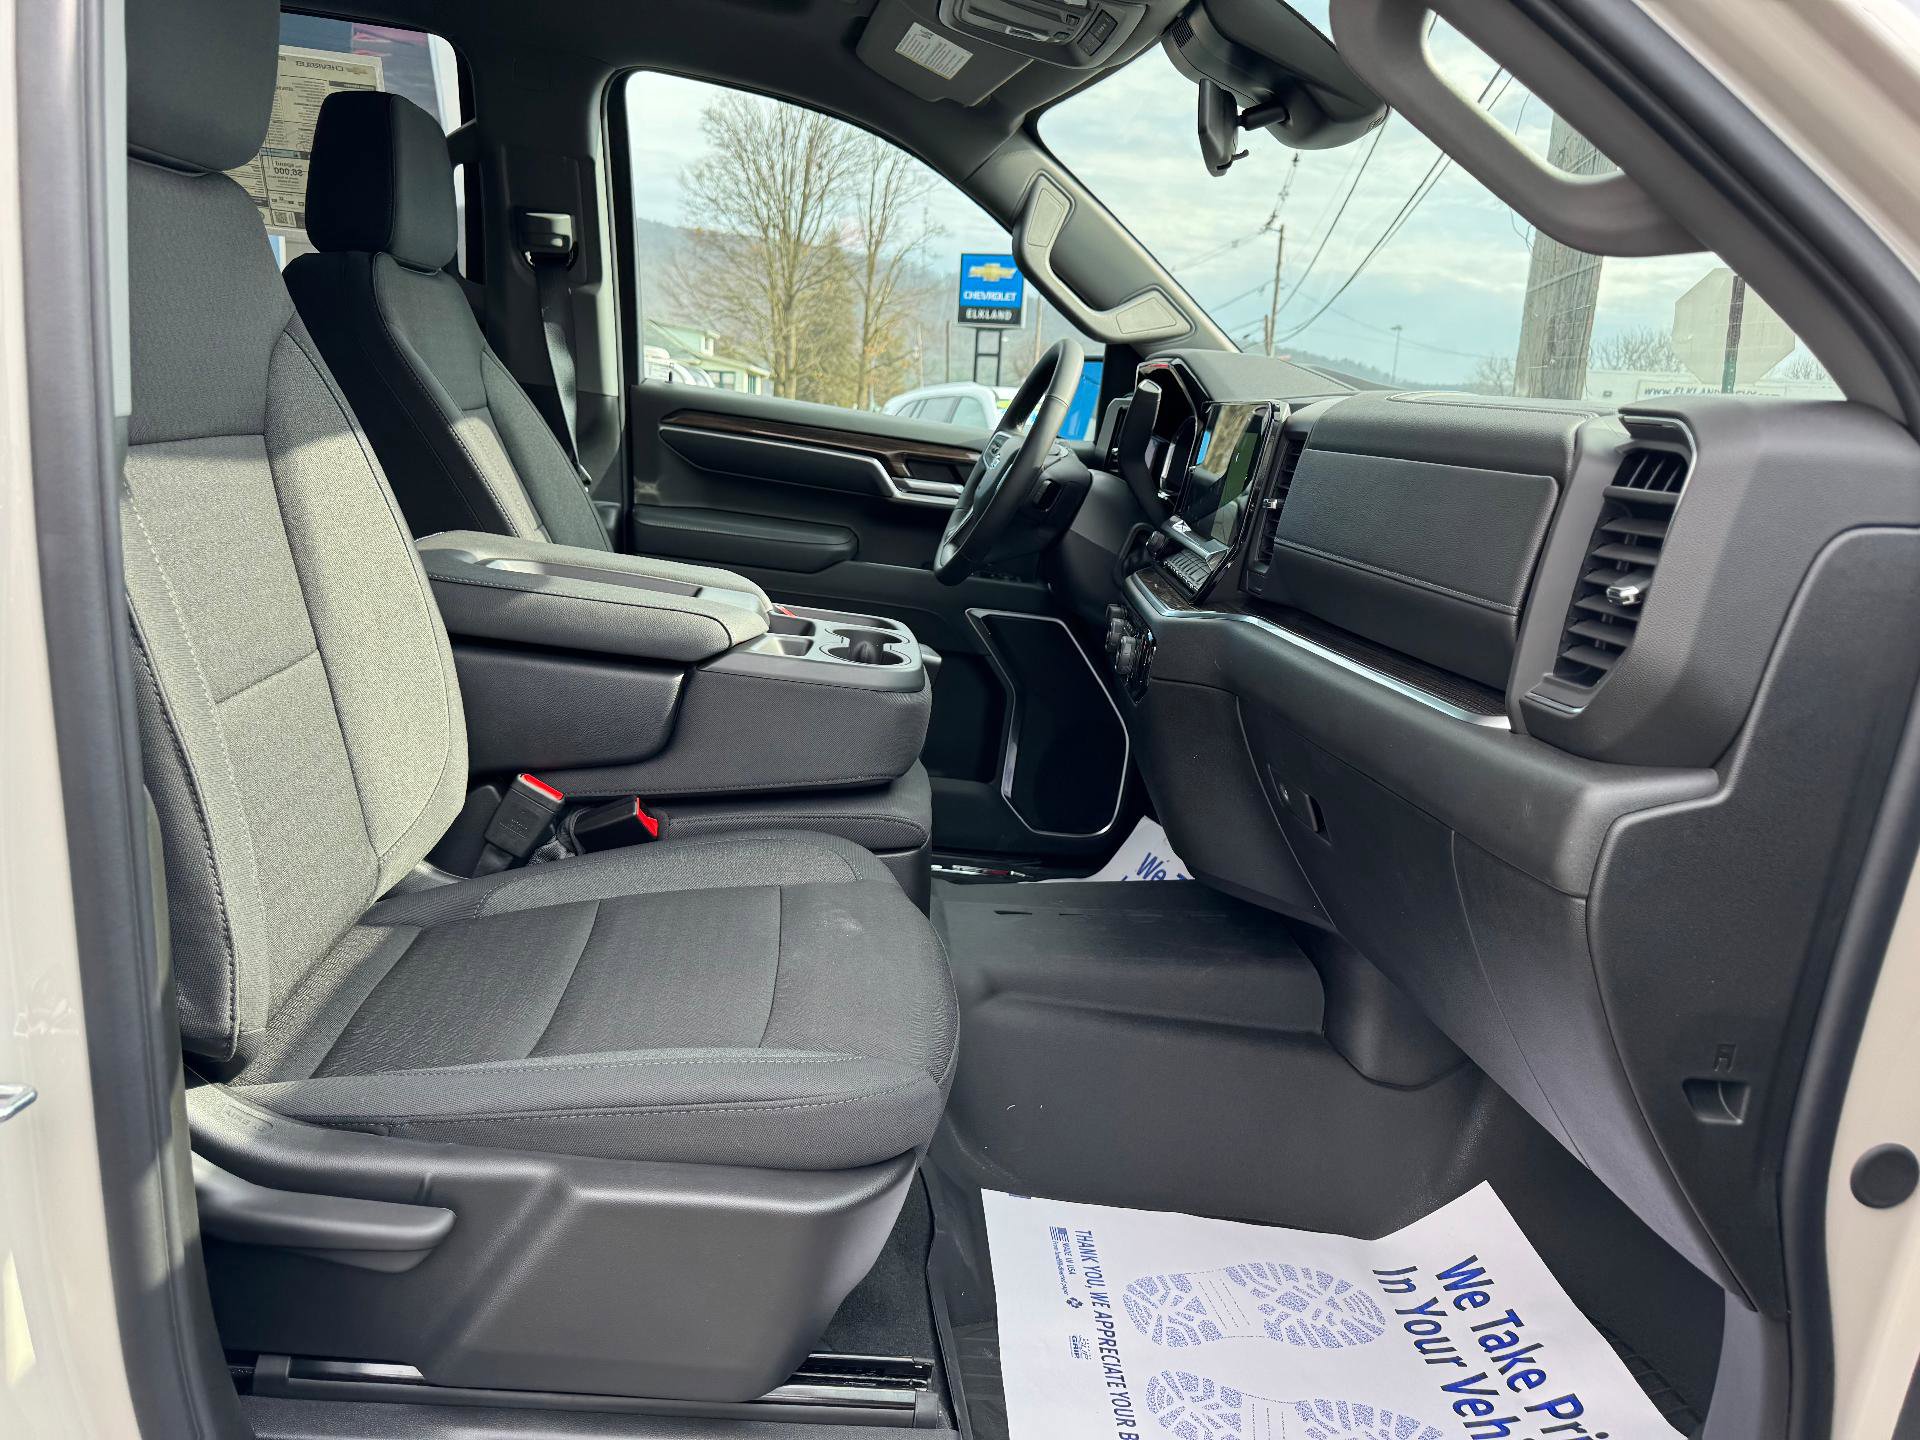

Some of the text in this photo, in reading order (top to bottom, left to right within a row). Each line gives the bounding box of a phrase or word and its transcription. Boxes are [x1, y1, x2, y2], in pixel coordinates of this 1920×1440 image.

[963, 290, 1017, 302] CHEVROLET
[965, 308, 1013, 321] ELKLAND
[1075, 1230, 1099, 1264] THANK
[1067, 1264, 1077, 1275] USA
[1082, 1265, 1105, 1288] YOU,
[1089, 1291, 1111, 1309] WE
[1372, 1265, 1418, 1294] In
[1395, 1296, 1468, 1368] Your
[1435, 1254, 1494, 1311] We
[1470, 1309, 1547, 1393] Take
[1093, 1310, 1127, 1389] APPRECIATE
[1109, 1391, 1137, 1428] YOUR
